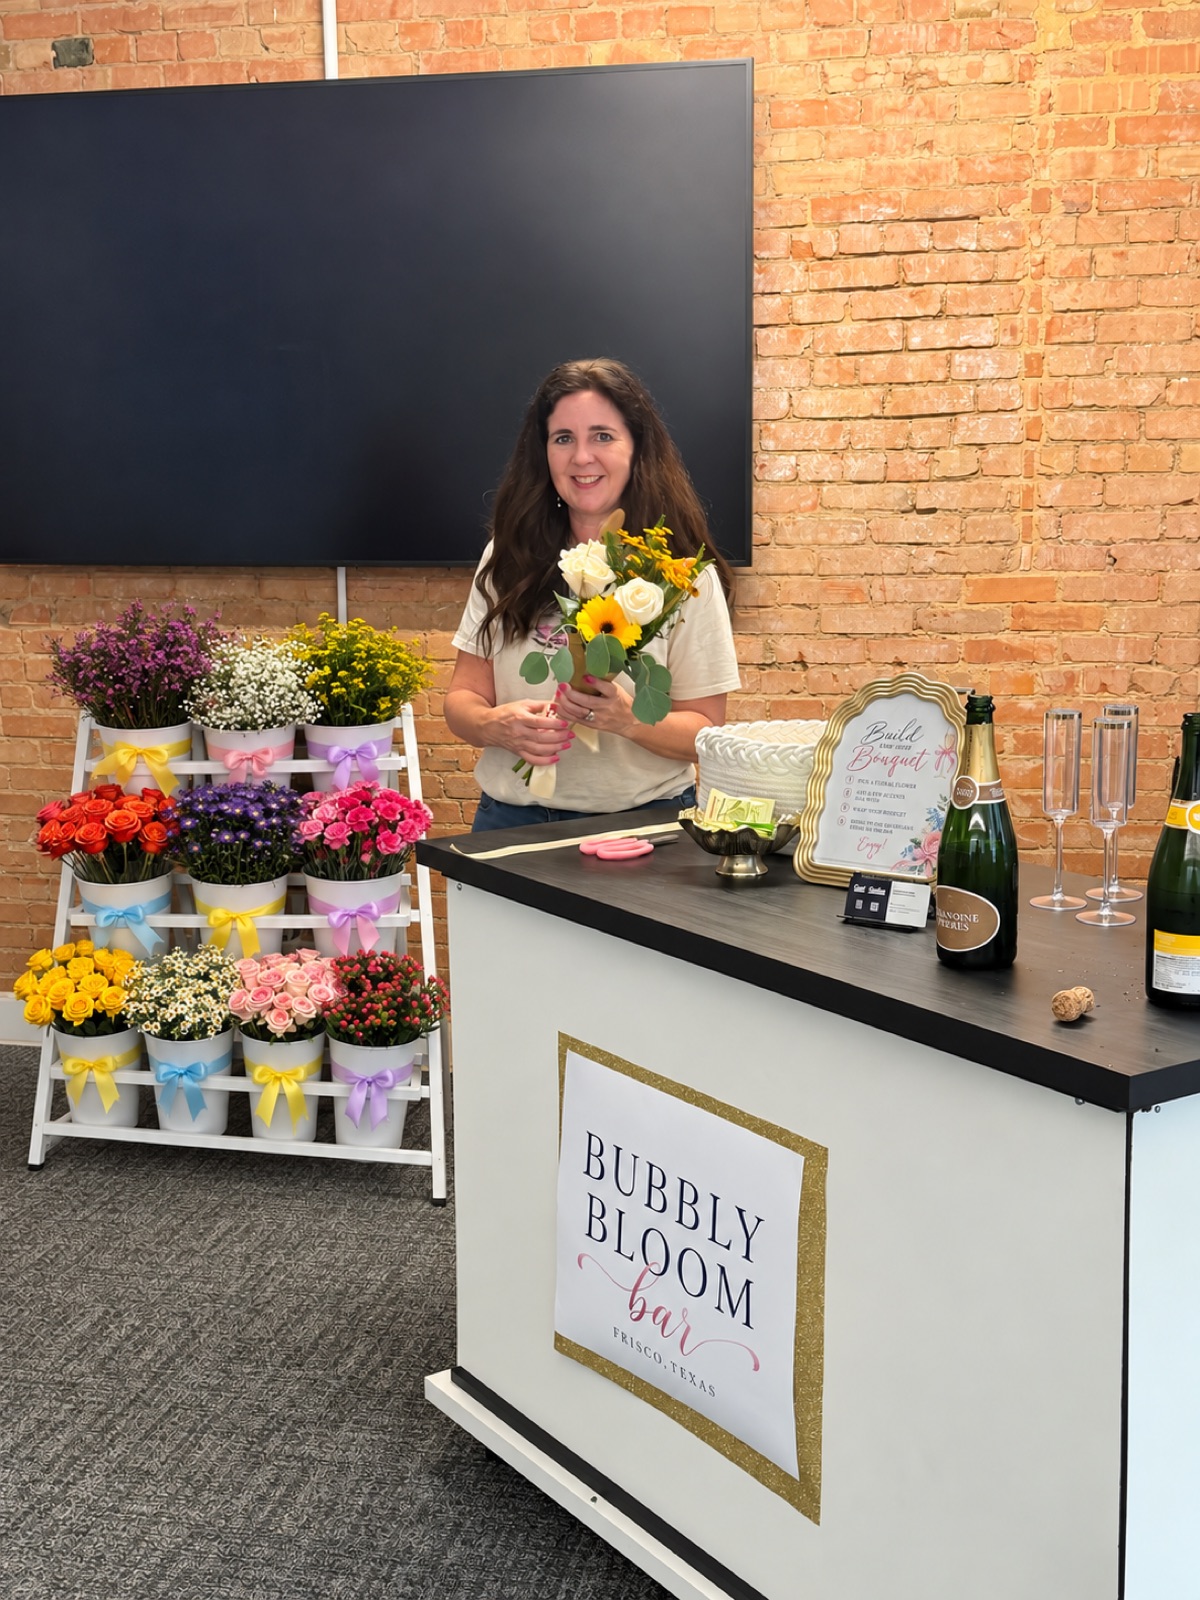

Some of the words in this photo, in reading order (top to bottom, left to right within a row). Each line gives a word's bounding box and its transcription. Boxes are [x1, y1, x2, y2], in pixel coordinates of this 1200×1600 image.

[861, 718, 924, 745] Build
[846, 745, 931, 778] Bouquet
[582, 1130, 765, 1263] BUBBLY
[584, 1192, 754, 1331] BLOOM
[670, 1360, 717, 1398] TEXAS
